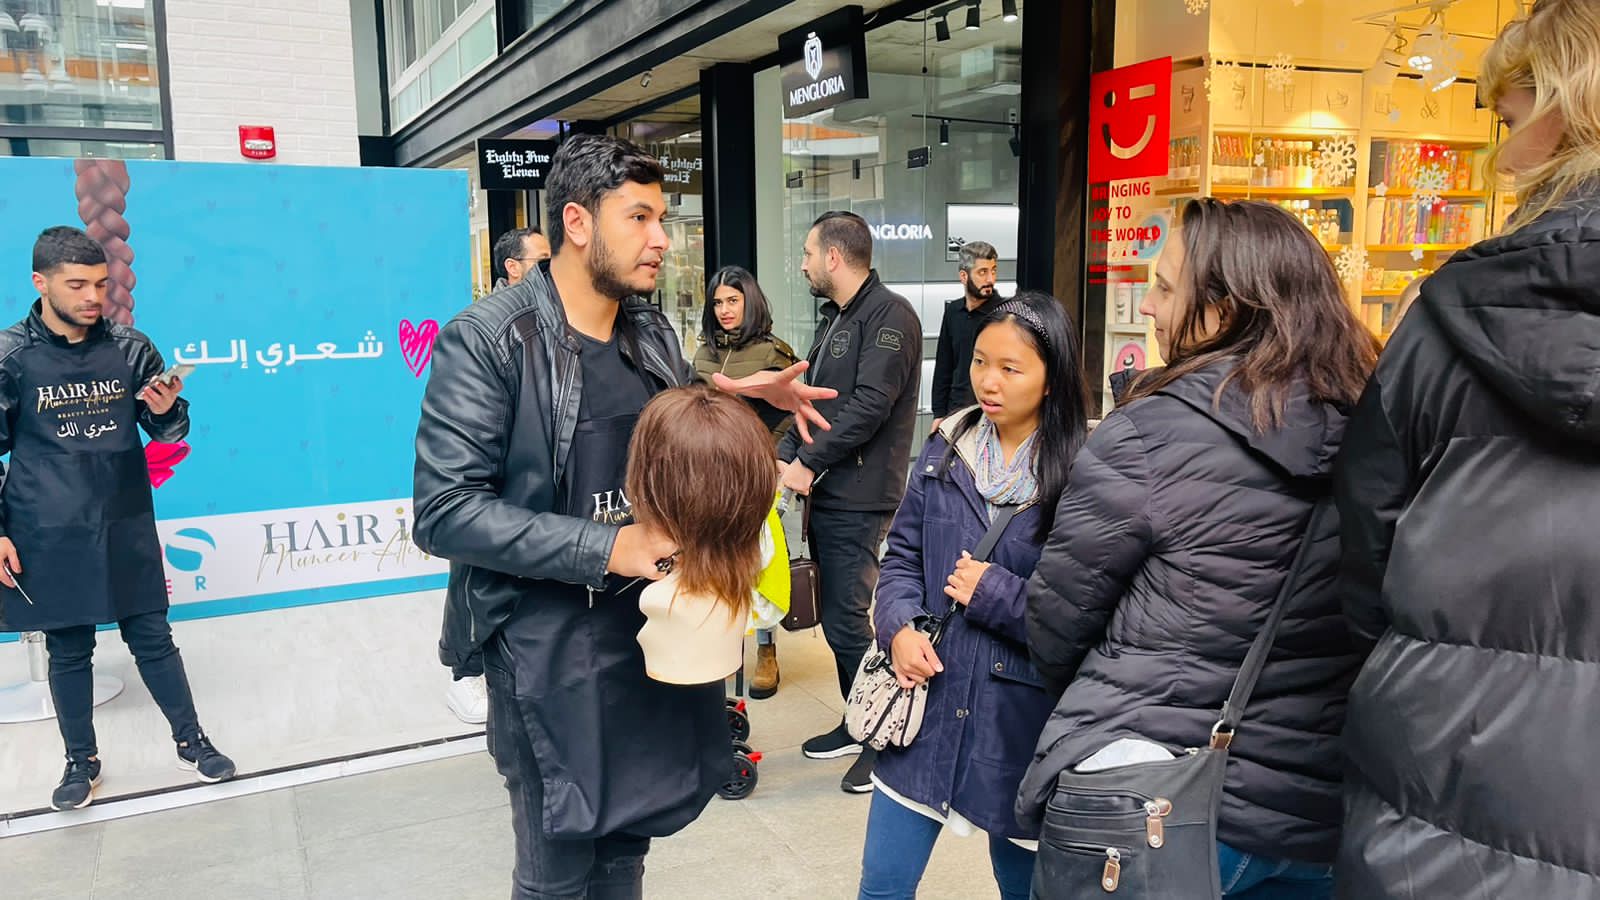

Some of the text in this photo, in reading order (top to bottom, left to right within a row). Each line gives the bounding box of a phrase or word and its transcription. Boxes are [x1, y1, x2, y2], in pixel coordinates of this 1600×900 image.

[789, 75, 845, 107] MENGLORIA
[485, 149, 550, 166] Eighty Five
[502, 164, 540, 178] Eleven
[1093, 205, 1131, 222] JOY TO
[869, 224, 934, 240] NGLORIA
[1091, 225, 1162, 243] THE WORLD
[255, 330, 383, 374] شعري
[83, 419, 117, 439] شعري
